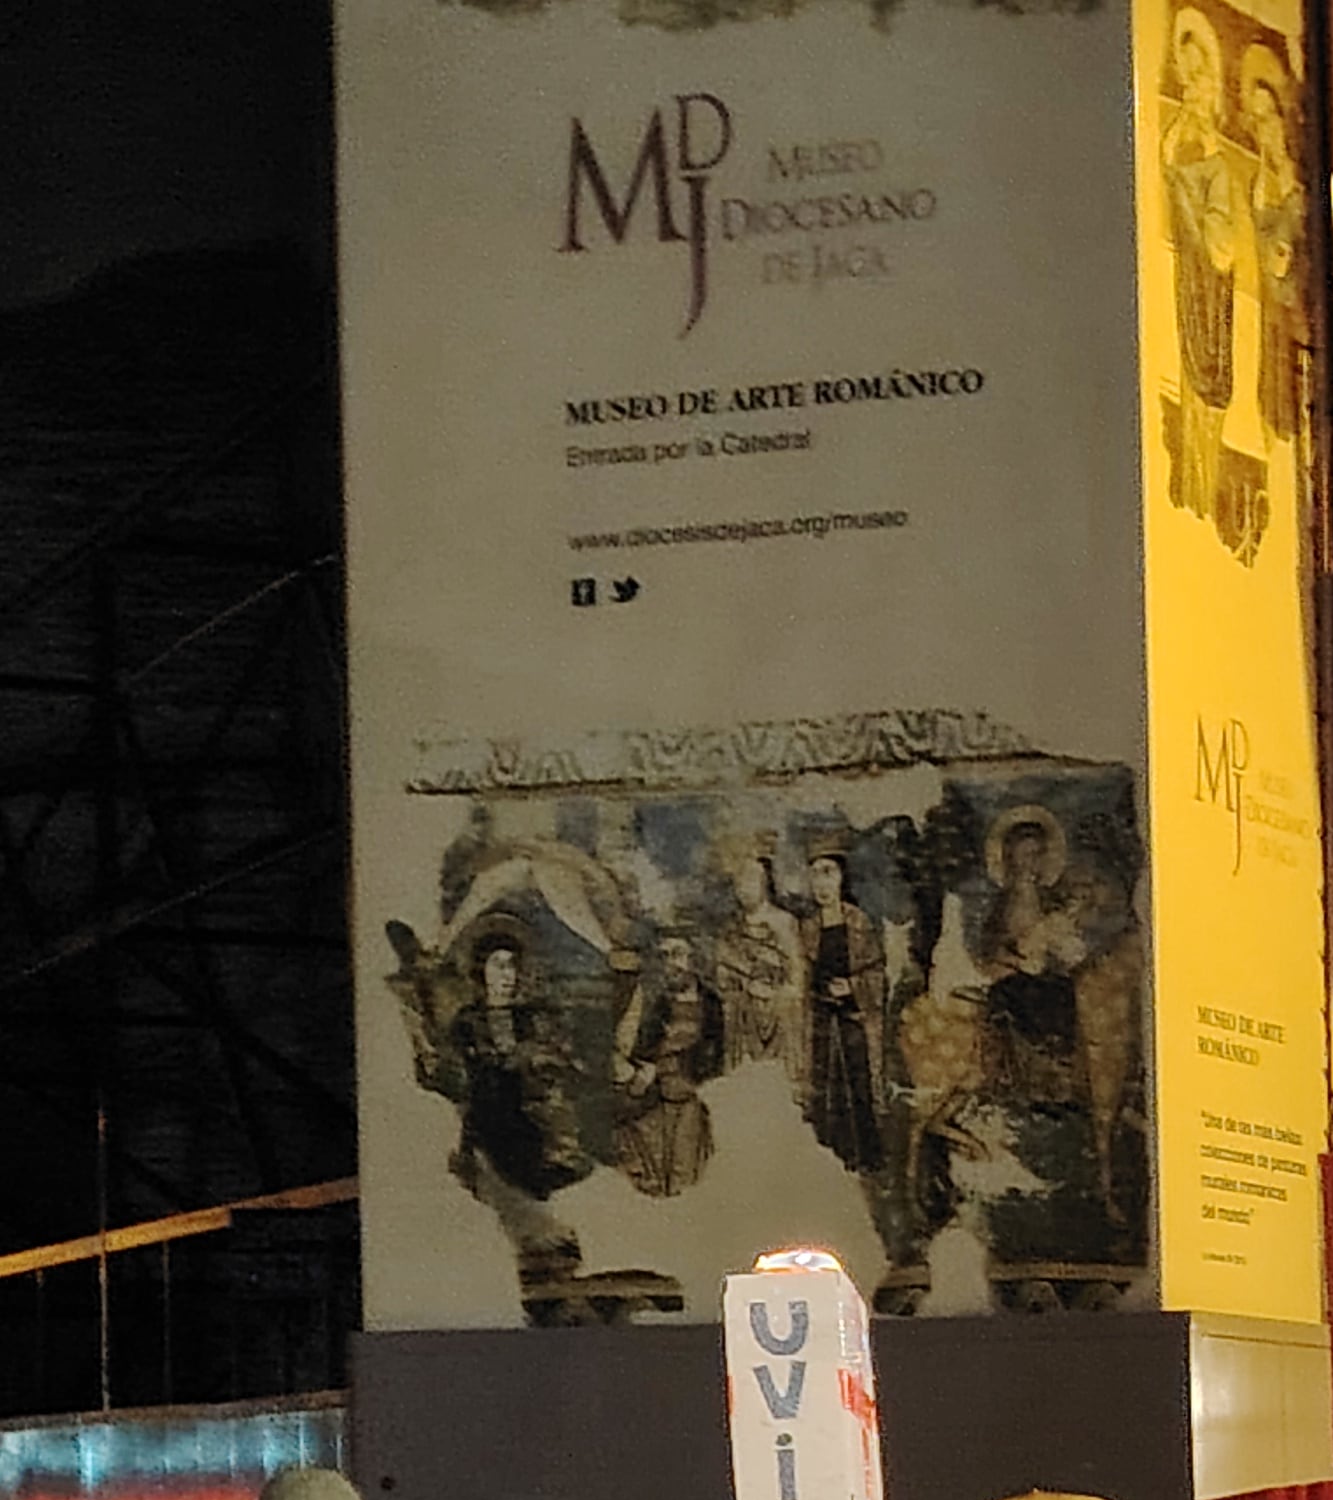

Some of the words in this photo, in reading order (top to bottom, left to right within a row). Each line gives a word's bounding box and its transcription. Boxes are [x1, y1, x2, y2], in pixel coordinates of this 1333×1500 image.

[721, 188, 937, 241] DIOCESANO
[565, 395, 669, 426] MUSEO
[678, 390, 718, 417] DE
[727, 381, 805, 411] ARTE
[813, 368, 985, 405] ROMÁNICO
[566, 443, 648, 468] Entrada
[654, 442, 689, 463] por
[698, 435, 715, 457] la
[720, 428, 811, 456] Catedral
[1197, 1006, 1236, 1031] MUSEO
[1239, 1014, 1254, 1036] DE
[1257, 1020, 1286, 1044] ARTE
